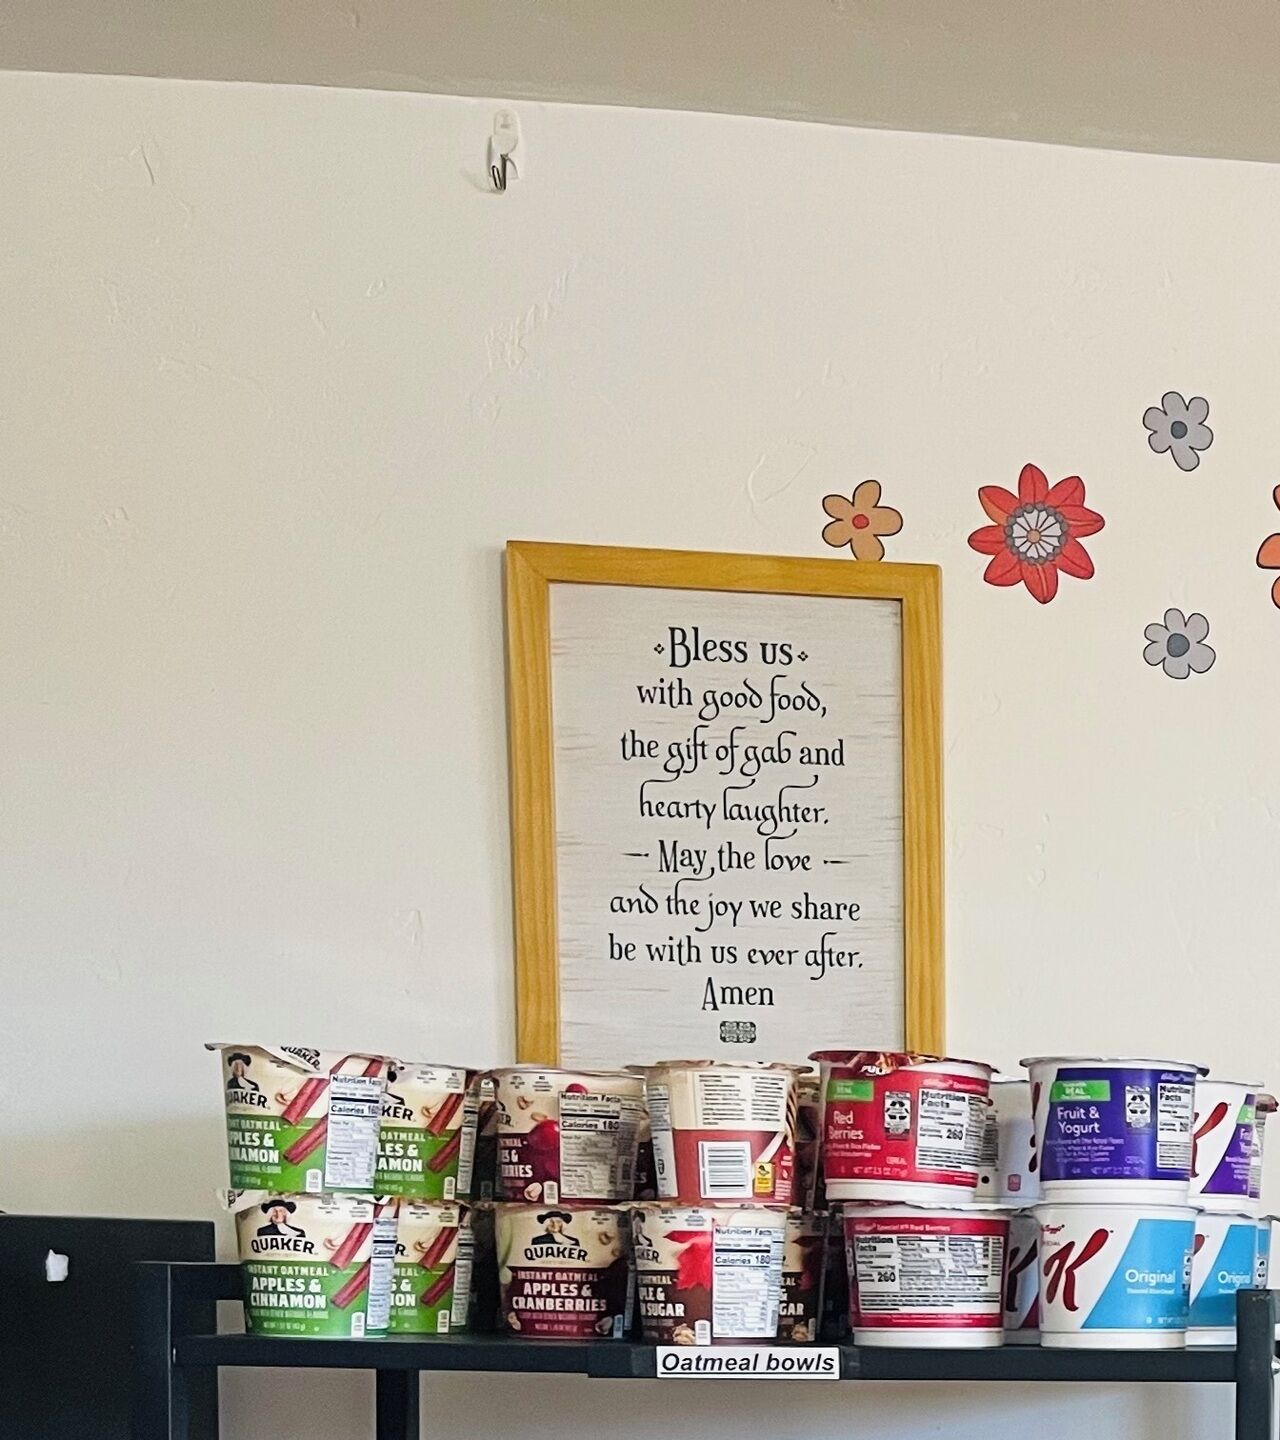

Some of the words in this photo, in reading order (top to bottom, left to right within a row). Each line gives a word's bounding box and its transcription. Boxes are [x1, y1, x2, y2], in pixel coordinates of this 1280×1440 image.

[668, 627, 748, 668] Bless
[759, 642, 793, 666] us
[636, 678, 692, 708] with
[698, 678, 762, 721] good
[760, 675, 827, 723] food,
[621, 731, 659, 762] the
[663, 725, 708, 775] gift
[714, 727, 747, 775] of
[739, 731, 797, 776] gab
[799, 739, 845, 767] and
[639, 772, 716, 829] hearty
[723, 775, 829, 836] laughter.
[718, 843, 755, 870] the
[764, 829, 812, 871] love
[610, 884, 658, 914] and
[666, 867, 714, 916] the
[695, 893, 742, 932] joy
[749, 897, 781, 919] we
[790, 893, 861, 921] share
[608, 933, 636, 961] be
[645, 936, 701, 966] with
[711, 943, 738, 964] us
[748, 949, 799, 966] ever
[805, 932, 863, 980] after.
[702, 977, 775, 1011] Amen
[1160, 1093, 1182, 1101] Facts
[834, 1110, 853, 1124] Red
[1057, 1107, 1085, 1119] Fruit
[1089, 1107, 1100, 1119] &
[829, 1126, 864, 1139] Berries
[947, 1129, 962, 1140] 260
[1059, 1121, 1100, 1136] Yogurt
[251, 1237, 315, 1254] QUAKER
[524, 1247, 588, 1261] QUAKER
[715, 1256, 751, 1264] Calories
[280, 1265, 329, 1276] OATMEAL
[555, 1272, 598, 1281] OATMEAL
[877, 1272, 896, 1282] 260
[1125, 1269, 1175, 1285] Original
[252, 1278, 305, 1292] APPLES
[309, 1279, 321, 1292] &
[524, 1283, 578, 1296] APPLES
[581, 1285, 592, 1297] &
[251, 1295, 326, 1309] CINNAMON
[512, 1298, 607, 1311] CRANBERRIES
[662, 1353, 758, 1371] Oatmeal
[766, 1353, 834, 1371] bowls
